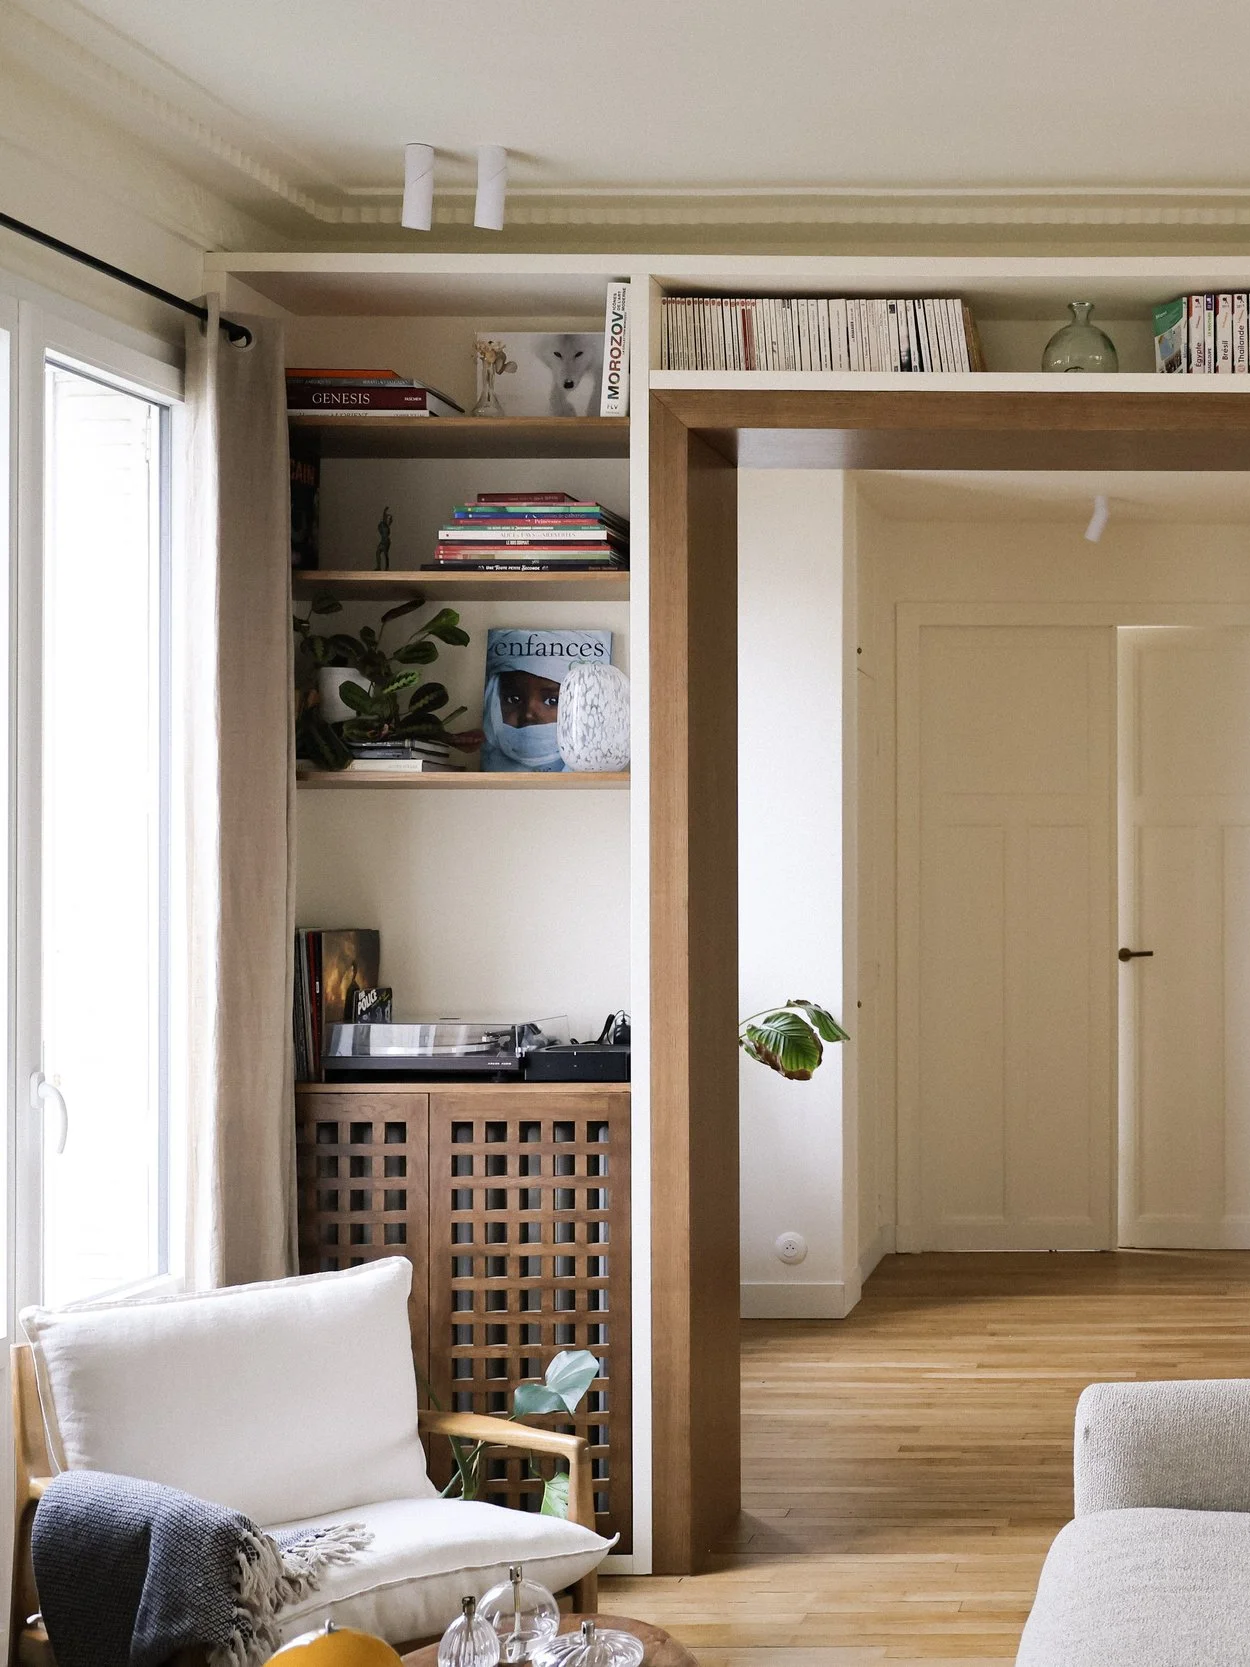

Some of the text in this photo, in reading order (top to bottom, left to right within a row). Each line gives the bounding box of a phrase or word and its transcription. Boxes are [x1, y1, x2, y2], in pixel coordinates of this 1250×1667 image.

[608, 311, 624, 399] MOROZOV
[1221, 340, 1229, 361] Brésil
[312, 392, 370, 405] GENESIS
[495, 634, 604, 657] enfances
[358, 989, 377, 1015] POLICE
